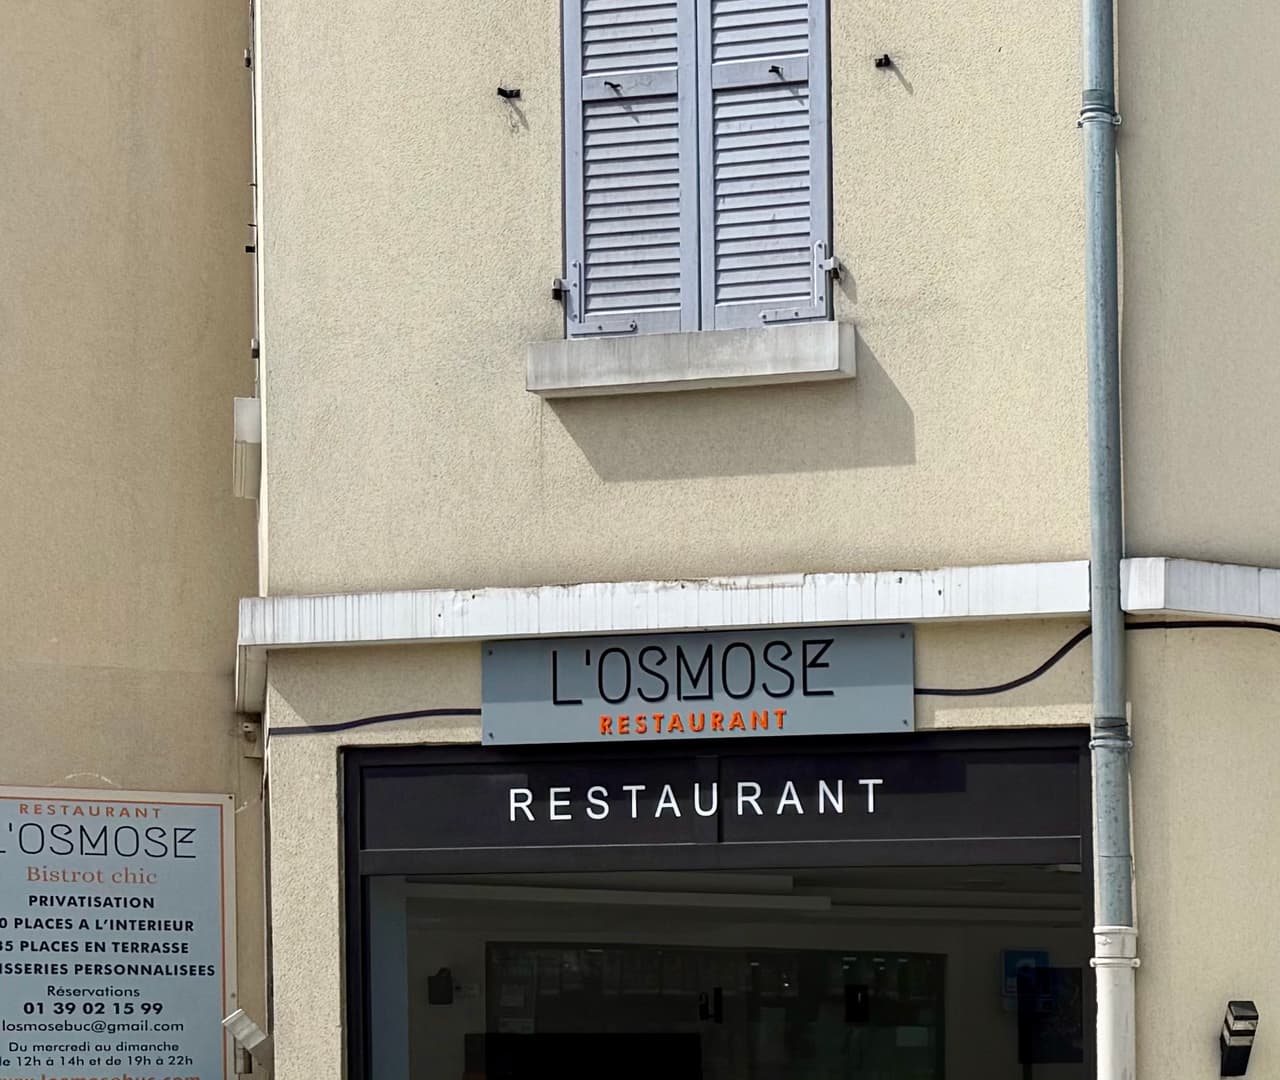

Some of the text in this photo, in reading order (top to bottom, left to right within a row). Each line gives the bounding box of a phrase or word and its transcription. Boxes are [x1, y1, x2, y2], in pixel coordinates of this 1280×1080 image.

[552, 638, 835, 706] L'OSMOSE
[600, 708, 787, 735] RESTAURANT
[509, 779, 883, 821] RESTAURANT
[20, 804, 160, 818] RESTAURANT
[0, 822, 197, 858] 'OSMOSE
[27, 865, 157, 884] Bistrot chic
[29, 896, 154, 908] PRIVATISATION
[14, 918, 72, 929] PLACES
[79, 919, 90, 930] A
[95, 919, 194, 931] L'INTERIEUR
[20, 941, 79, 952] PLACES
[85, 942, 106, 953] EN
[112, 942, 189, 954] TERRASSE
[0, 963, 215, 976] ISSERIES PERSONNALISEES
[47, 985, 140, 997] Réservations
[23, 1002, 163, 1014] 01 39 02 15 99
[2, 1020, 184, 1034] losmosebuc@gmail.com
[9, 1041, 179, 1052] Du mercredi au dimanche
[0, 1055, 193, 1066] e 12h à 14h et de 19h à 22h
